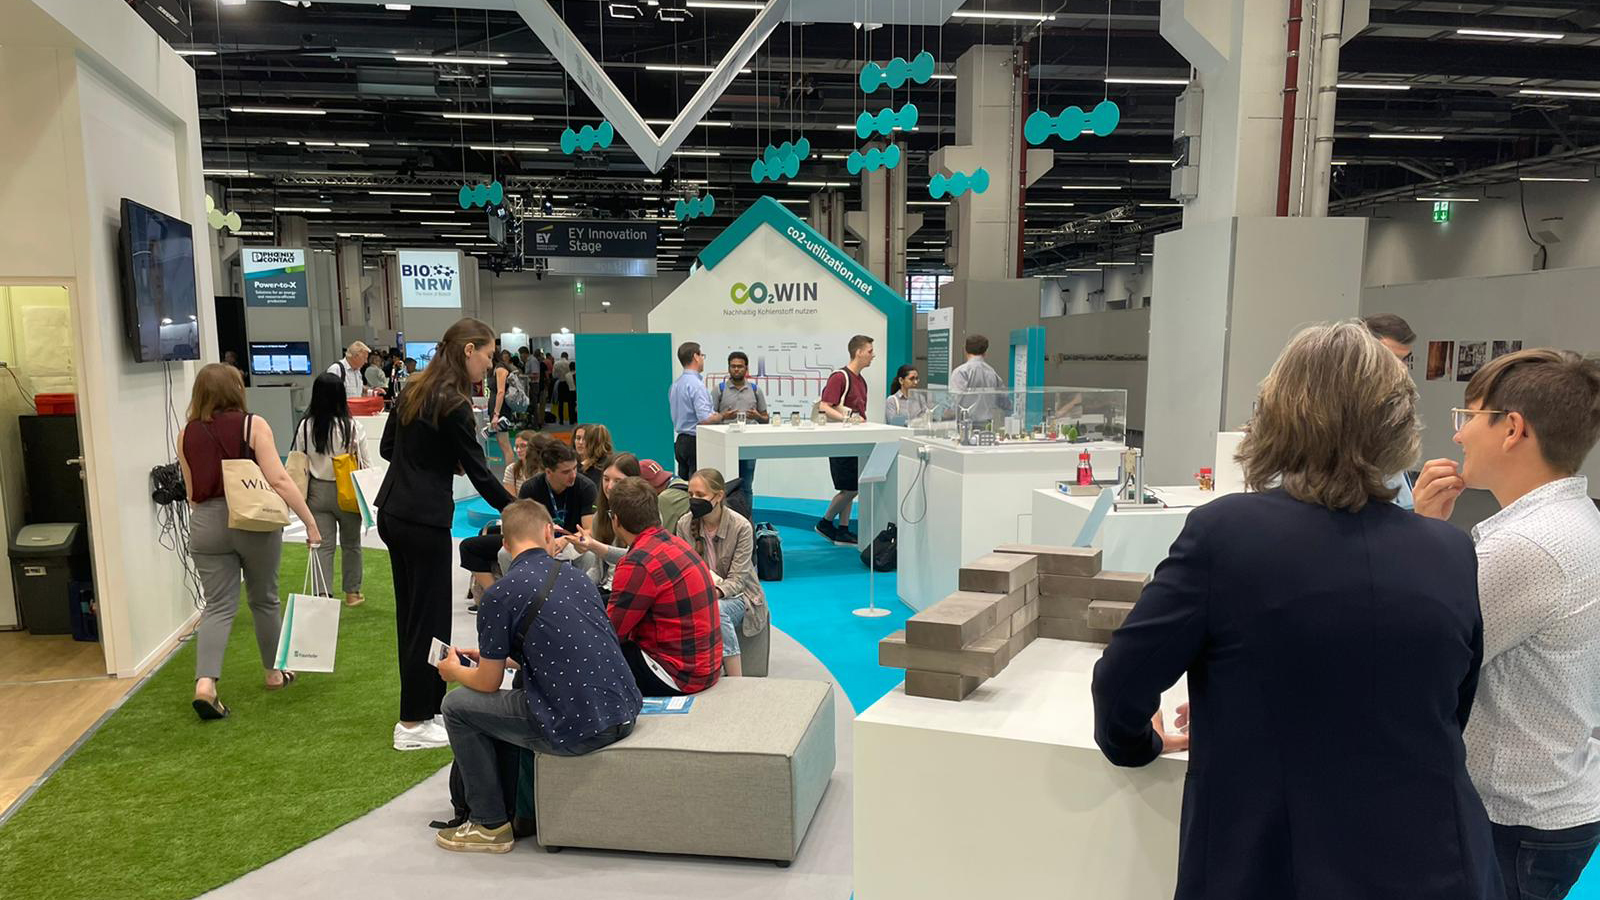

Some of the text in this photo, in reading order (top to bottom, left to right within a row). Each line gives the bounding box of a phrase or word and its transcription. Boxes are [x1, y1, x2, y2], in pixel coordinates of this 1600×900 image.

[535, 233, 551, 243] EY
[568, 228, 647, 240] EY Innovation
[568, 240, 602, 254] Stage
[786, 226, 873, 296] co2-utilization.net
[254, 281, 297, 289] Power-to-X
[414, 278, 452, 291] NRW
[757, 307, 794, 316] Kohlenstoff
[794, 307, 818, 315] nutzen
[241, 478, 273, 491] WIL
